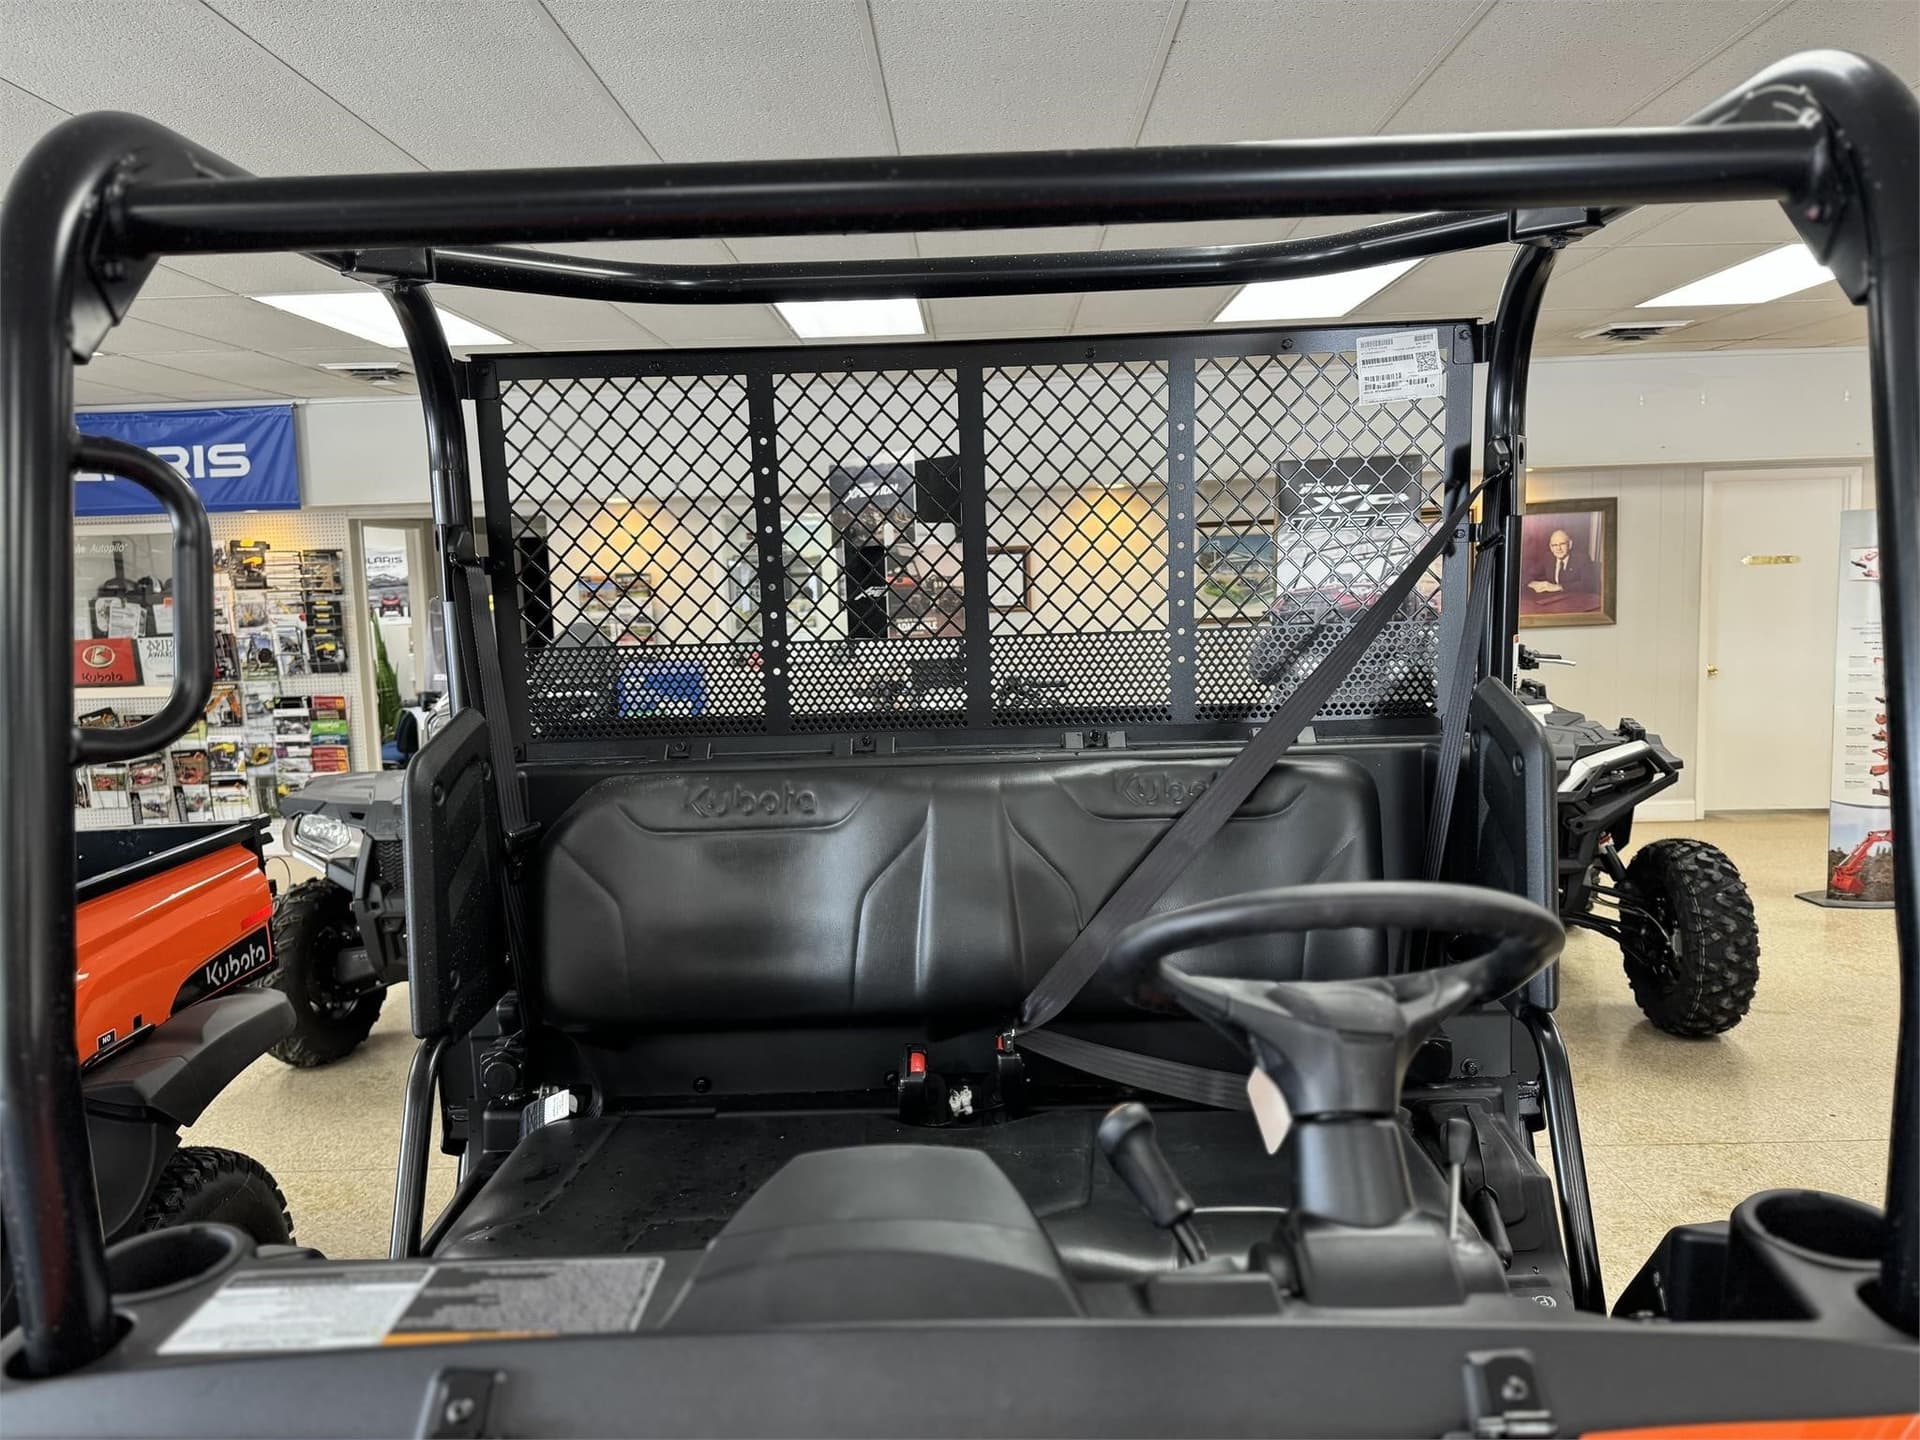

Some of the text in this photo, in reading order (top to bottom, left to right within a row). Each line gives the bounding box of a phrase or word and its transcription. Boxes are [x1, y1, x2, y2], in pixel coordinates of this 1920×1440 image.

[82, 671, 123, 682] Kubota
[684, 781, 818, 817] Kubota
[206, 943, 266, 986] Kubota
